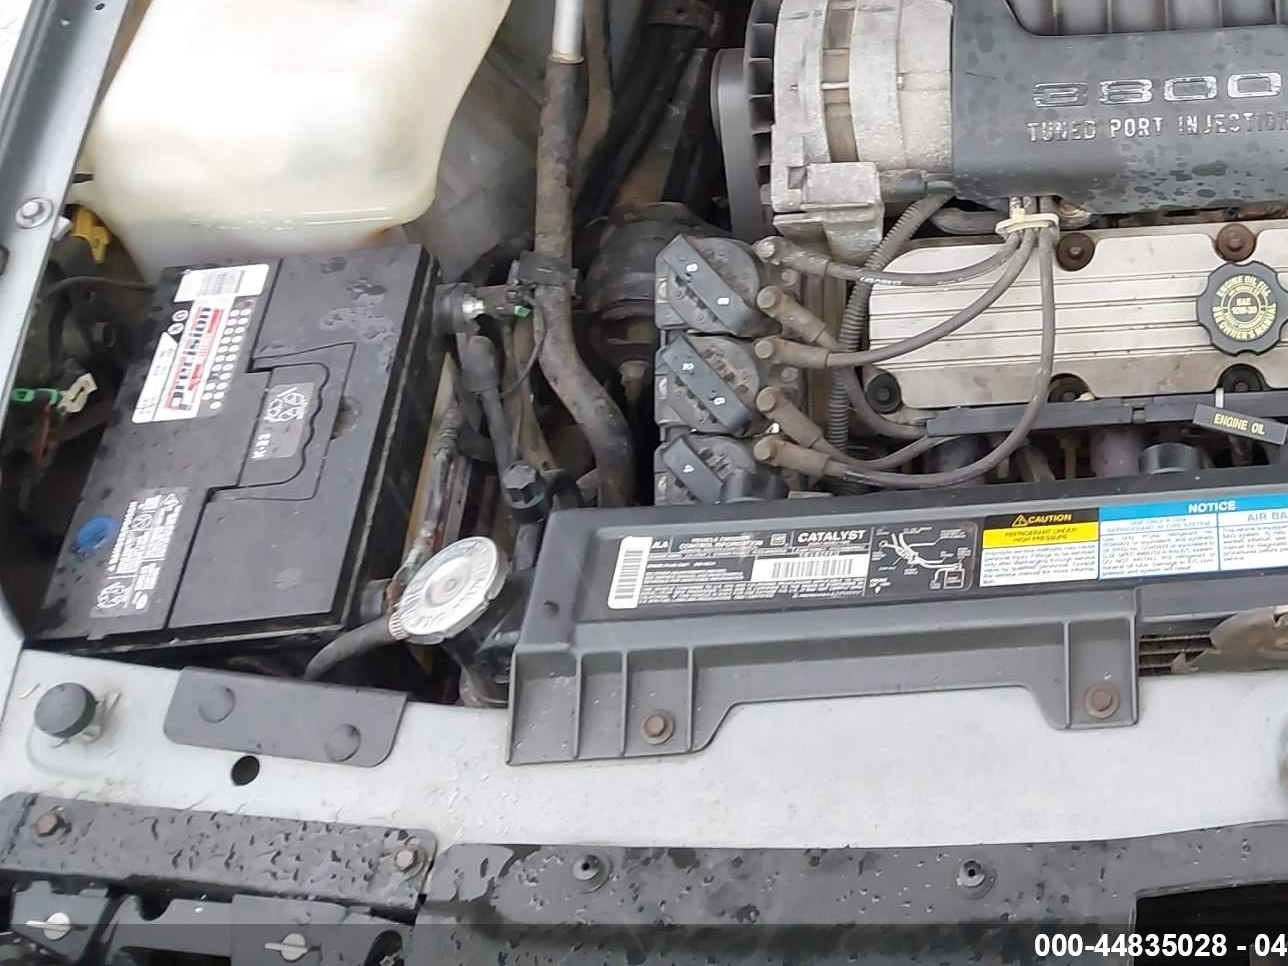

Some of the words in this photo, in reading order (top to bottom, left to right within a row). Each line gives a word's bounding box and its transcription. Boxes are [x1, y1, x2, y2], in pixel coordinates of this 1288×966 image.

[1032, 72, 1283, 107] 3800
[1026, 120, 1096, 142] TUNED
[1110, 116, 1164, 138] PORT
[1216, 274, 1243, 297] ENGINE
[1244, 275, 1258, 286] OIL
[165, 306, 212, 412] precision
[1213, 413, 1248, 431] ENGINE
[1251, 422, 1266, 435] OIL
[1188, 499, 1237, 514] NOTICE
[1247, 512, 1268, 522] AIR
[1027, 513, 1072, 524] CAUTION
[797, 529, 866, 543] CATALYST
